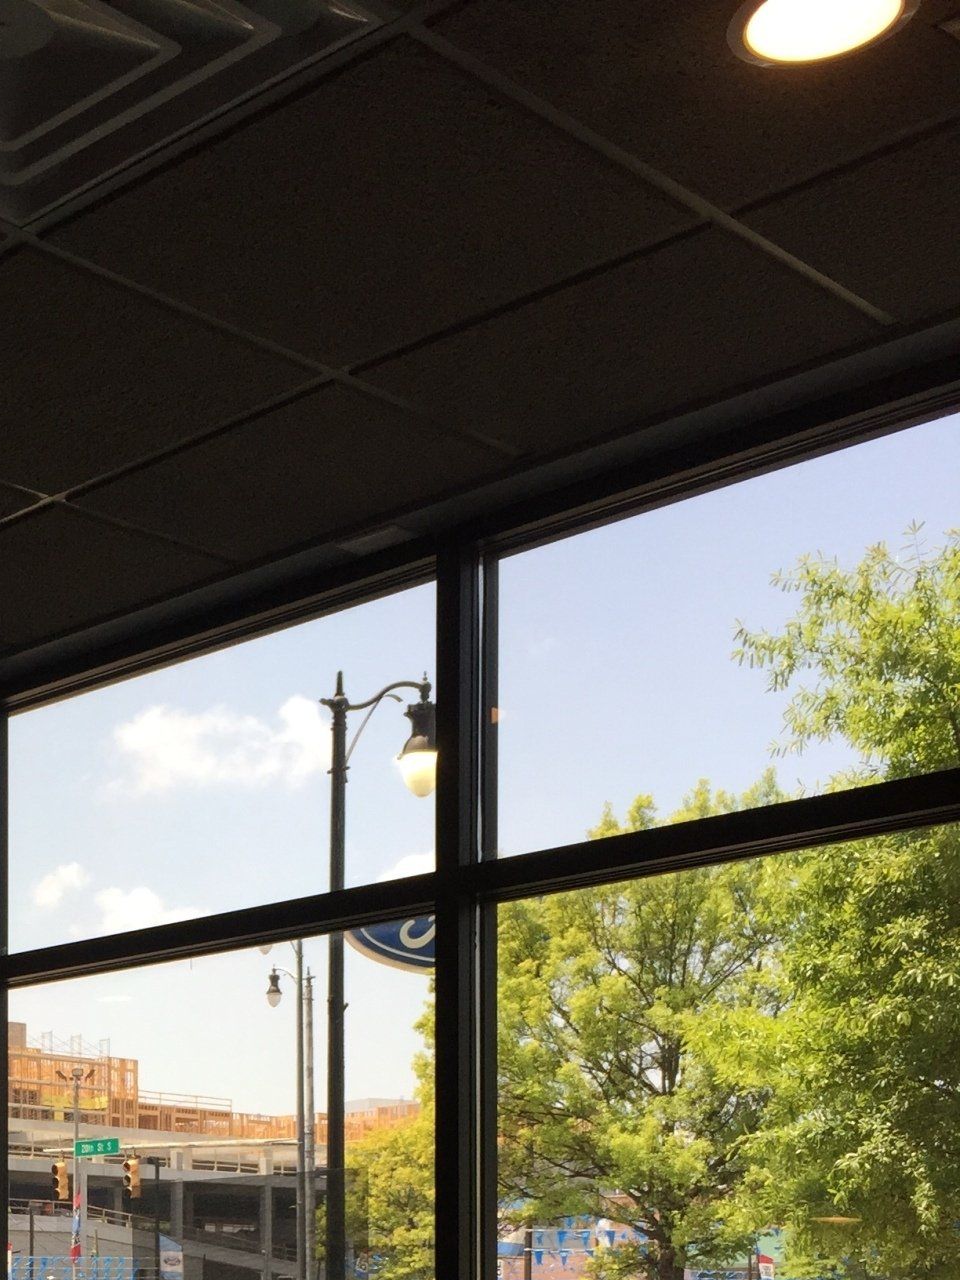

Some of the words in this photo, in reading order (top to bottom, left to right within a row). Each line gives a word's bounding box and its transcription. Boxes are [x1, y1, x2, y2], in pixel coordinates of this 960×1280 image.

[81, 1144, 95, 1154] 20th
[97, 1143, 104, 1152] St
[107, 1142, 112, 1151] S
